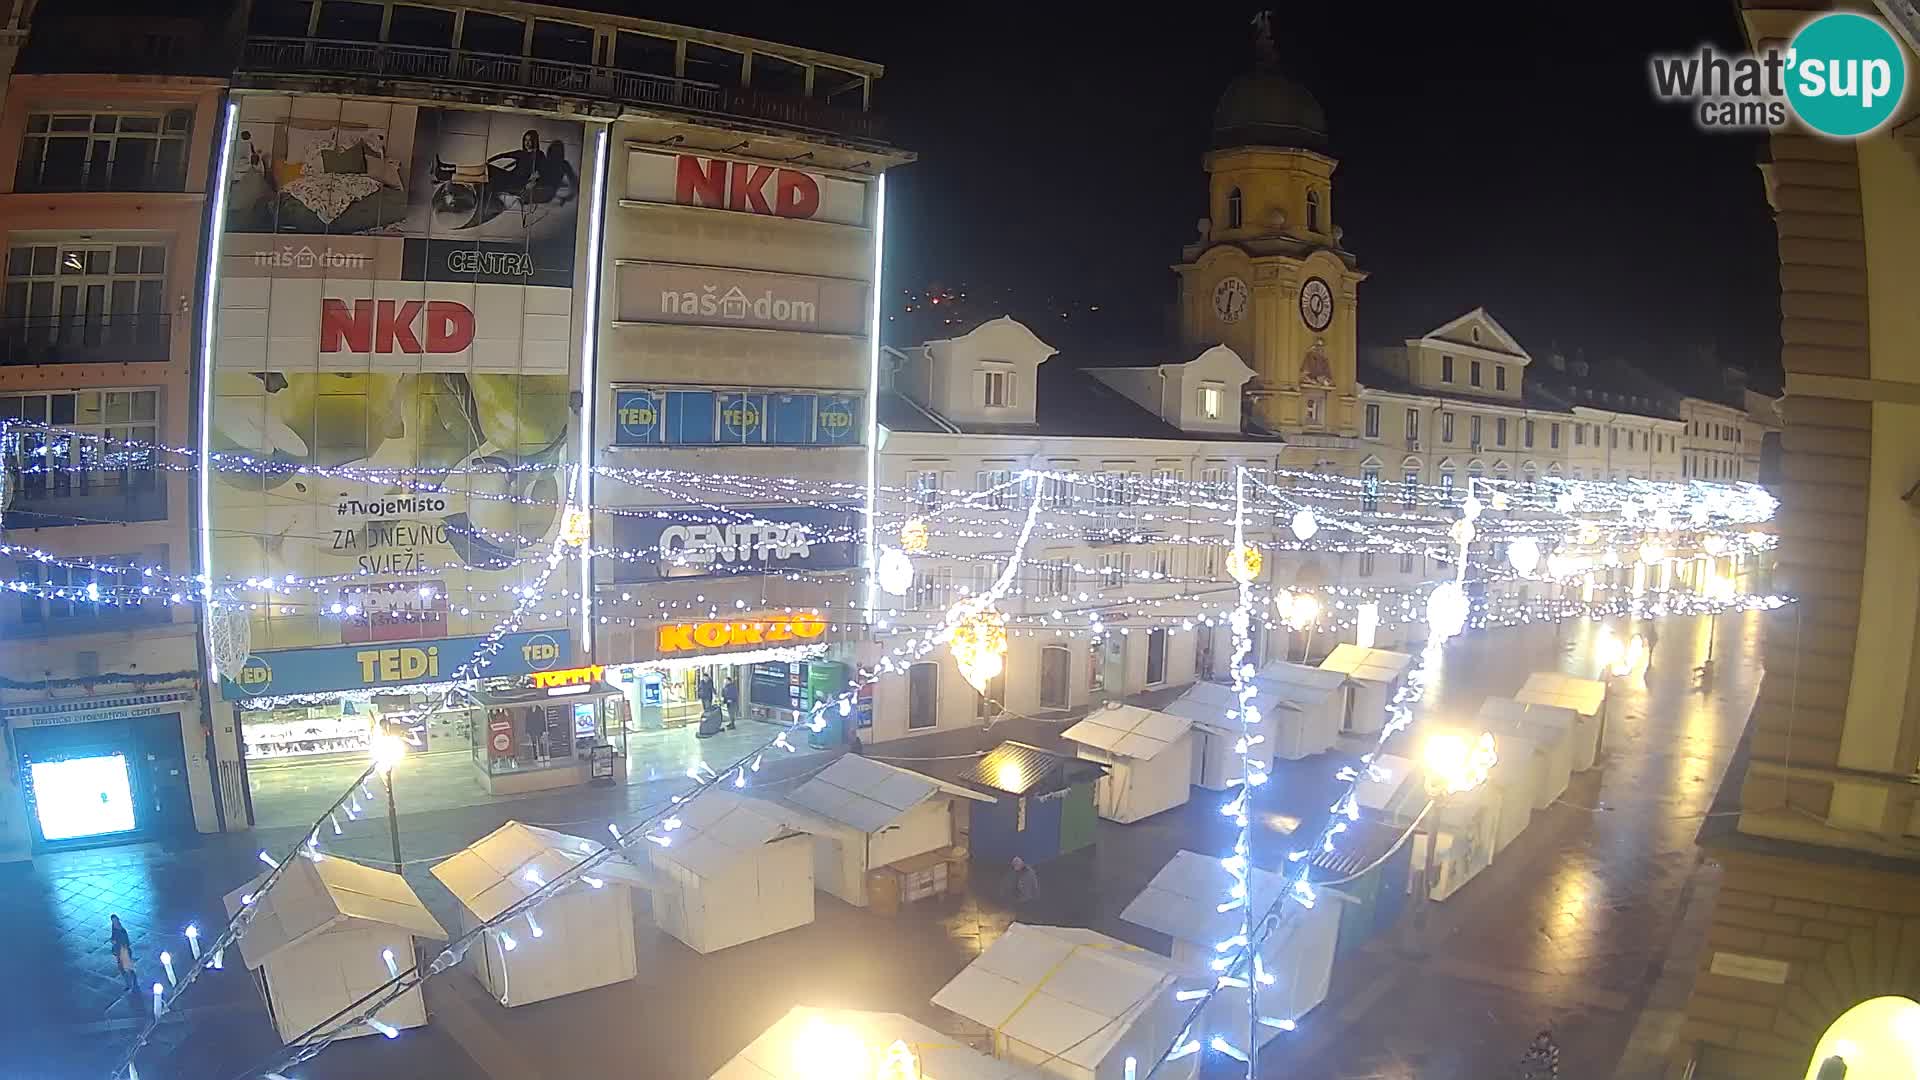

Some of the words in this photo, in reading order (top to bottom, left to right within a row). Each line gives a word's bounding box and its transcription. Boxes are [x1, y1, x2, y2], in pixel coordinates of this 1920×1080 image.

[676, 154, 820, 219] NKD
[254, 245, 292, 268] naš
[319, 248, 364, 269] dom
[447, 250, 534, 276] CENTRA
[661, 284, 718, 317] naš
[754, 290, 816, 322] dom
[320, 298, 476, 353] NKD
[618, 408, 657, 425] TEDi
[722, 410, 759, 426] TEDi
[337, 498, 445, 517] #TvojeMisto
[333, 529, 357, 549] ZA
[367, 524, 449, 548] DNEVNO
[659, 521, 810, 562] CENTRA
[358, 547, 425, 574] SVJEŽE
[658, 612, 826, 652] KORZO
[357, 646, 439, 684] TEDi
[522, 644, 559, 662] TEDi
